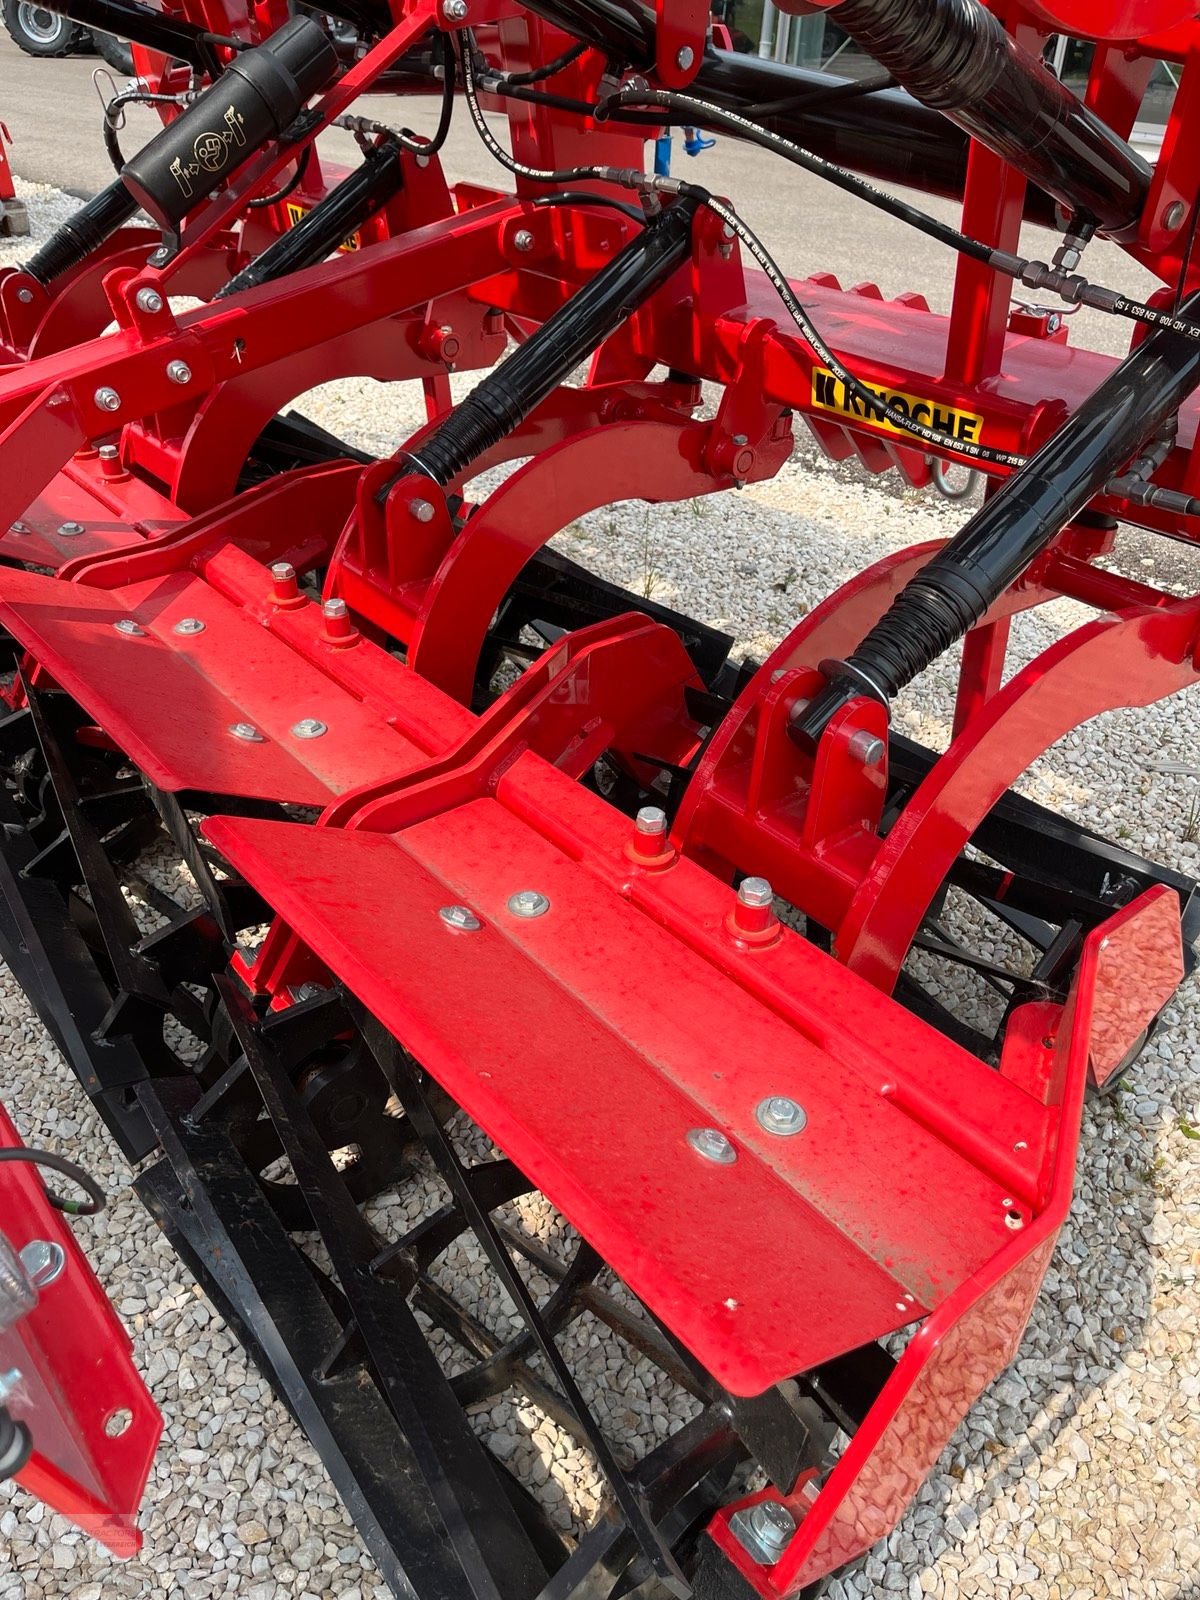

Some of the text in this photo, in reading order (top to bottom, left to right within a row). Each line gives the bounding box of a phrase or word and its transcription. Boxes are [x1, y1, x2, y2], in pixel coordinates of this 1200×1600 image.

[1131, 305, 1146, 317] 853
[1144, 310, 1158, 321] EN
[792, 309, 804, 326] BAR
[801, 325, 817, 345] MSHA
[1159, 315, 1174, 327] 108
[1172, 320, 1187, 332] HD
[844, 381, 978, 443] KNOCHE
[884, 408, 921, 433] HANSA-FLEX
[921, 428, 933, 439] HD
[943, 438, 954, 448] EN
[952, 440, 964, 452] 853
[969, 444, 980, 455] SN
[995, 453, 1007, 463] WP
[1006, 456, 1018, 466] 215
